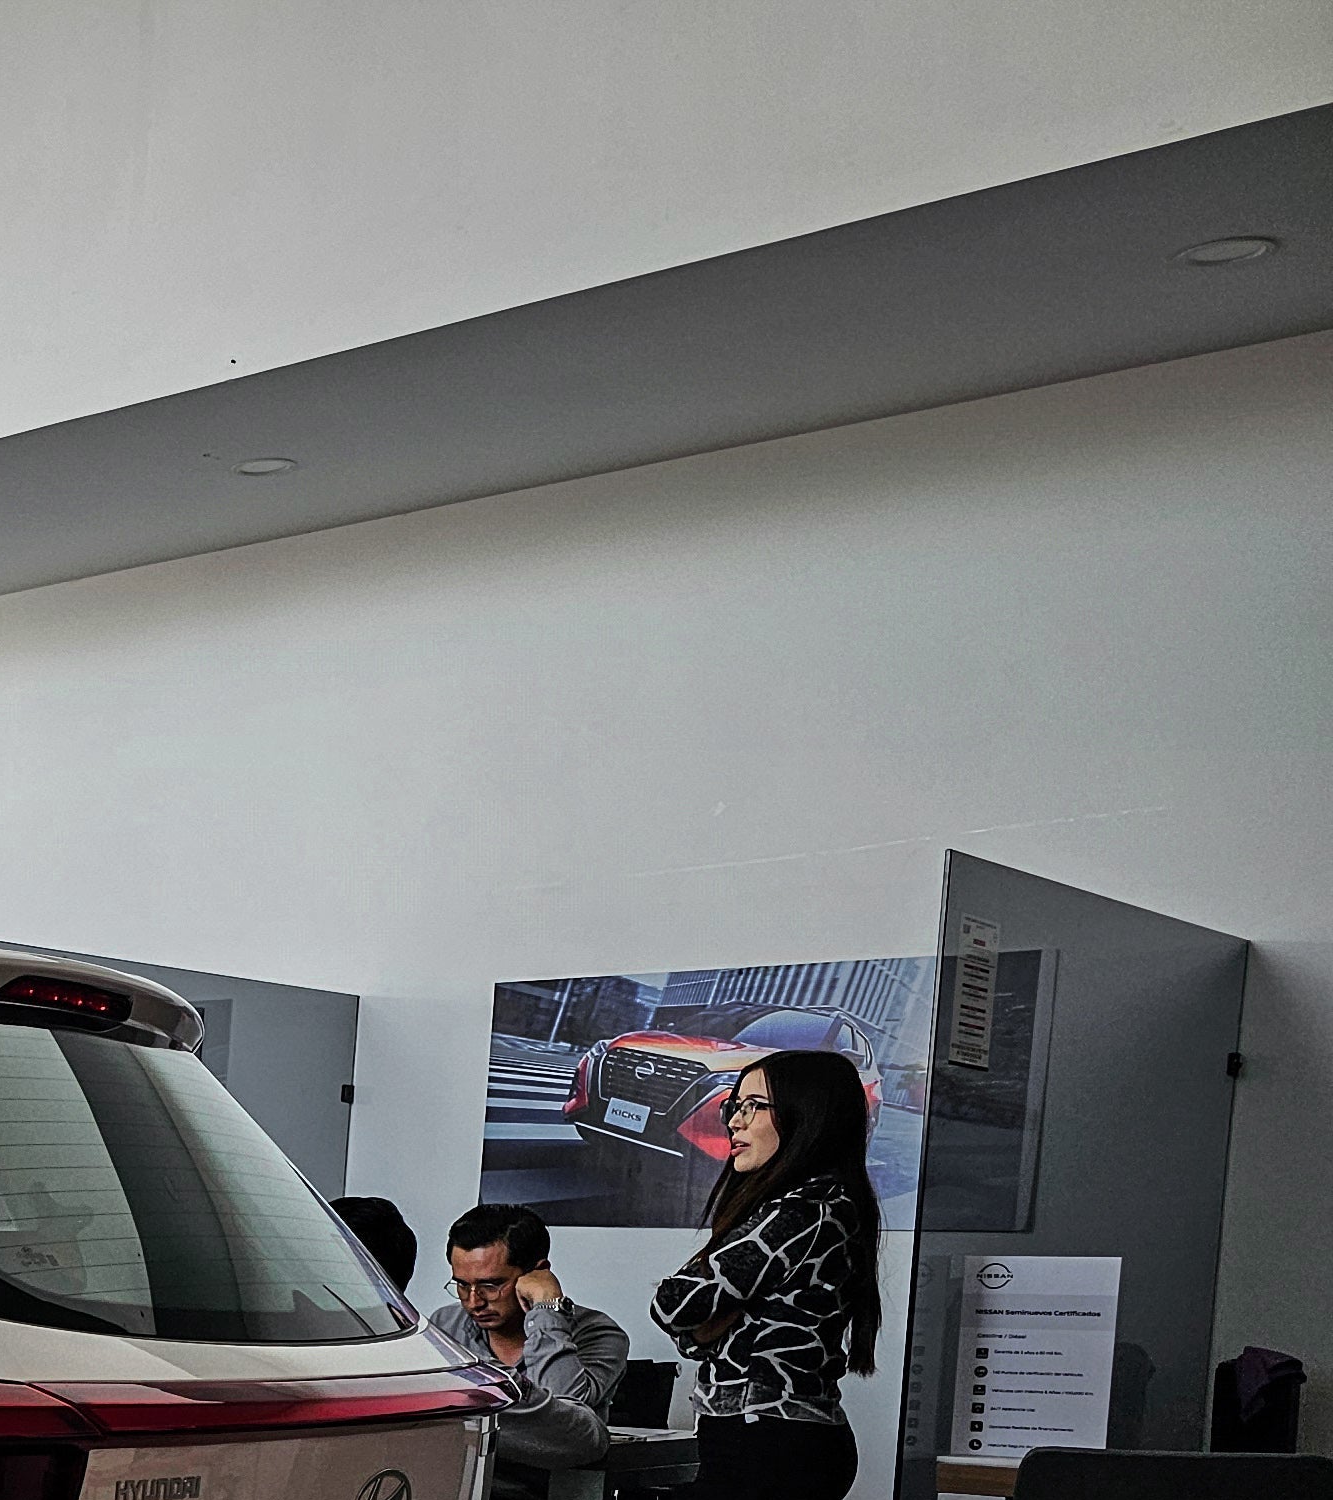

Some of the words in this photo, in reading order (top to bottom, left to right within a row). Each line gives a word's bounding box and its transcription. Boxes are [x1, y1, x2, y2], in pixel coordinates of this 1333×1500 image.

[611, 1107, 642, 1122] KICKS
[1005, 1309, 1052, 1317] Seminuevos
[1054, 1310, 1101, 1318] Certificados
